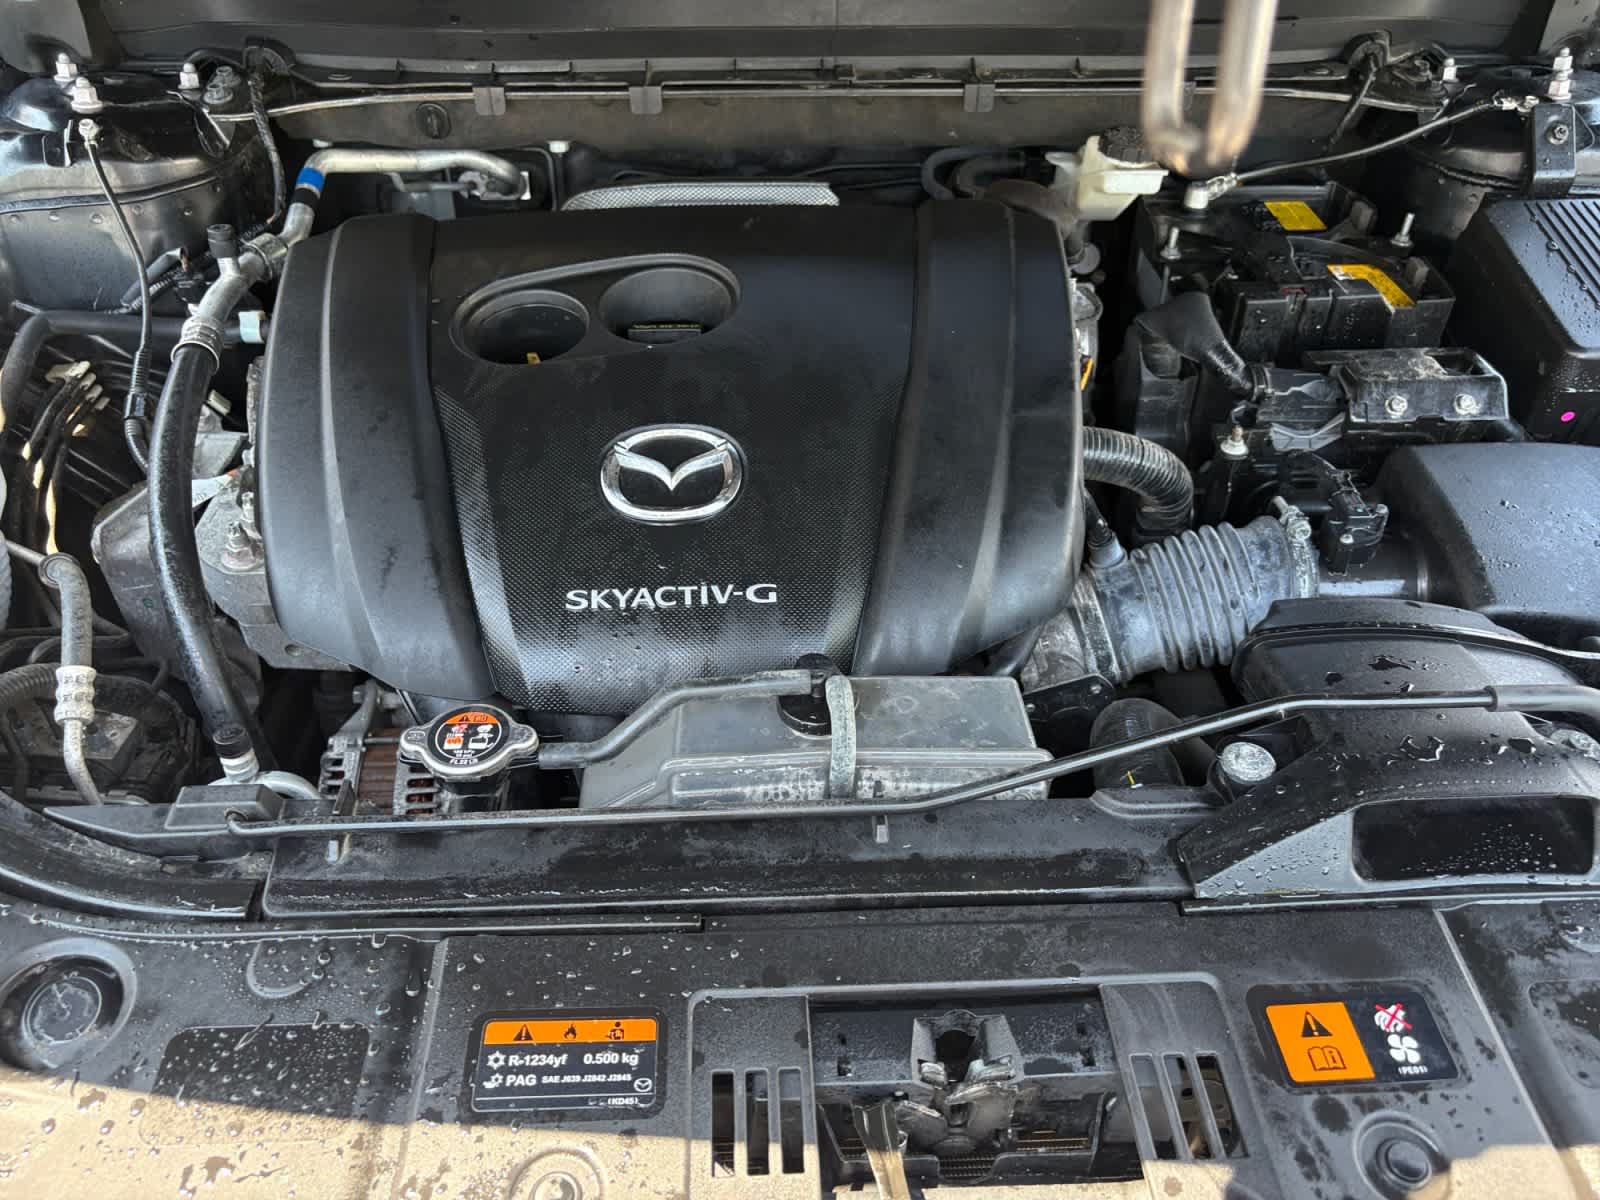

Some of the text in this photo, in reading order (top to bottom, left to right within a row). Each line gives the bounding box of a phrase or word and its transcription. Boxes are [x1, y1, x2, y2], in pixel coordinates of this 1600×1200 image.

[565, 582, 777, 610] SKYACTIV-G
[508, 1052, 639, 1068] R-1234yf 0.500 kg
[505, 1074, 537, 1087] PAG
[541, 1075, 560, 1083] SAE
